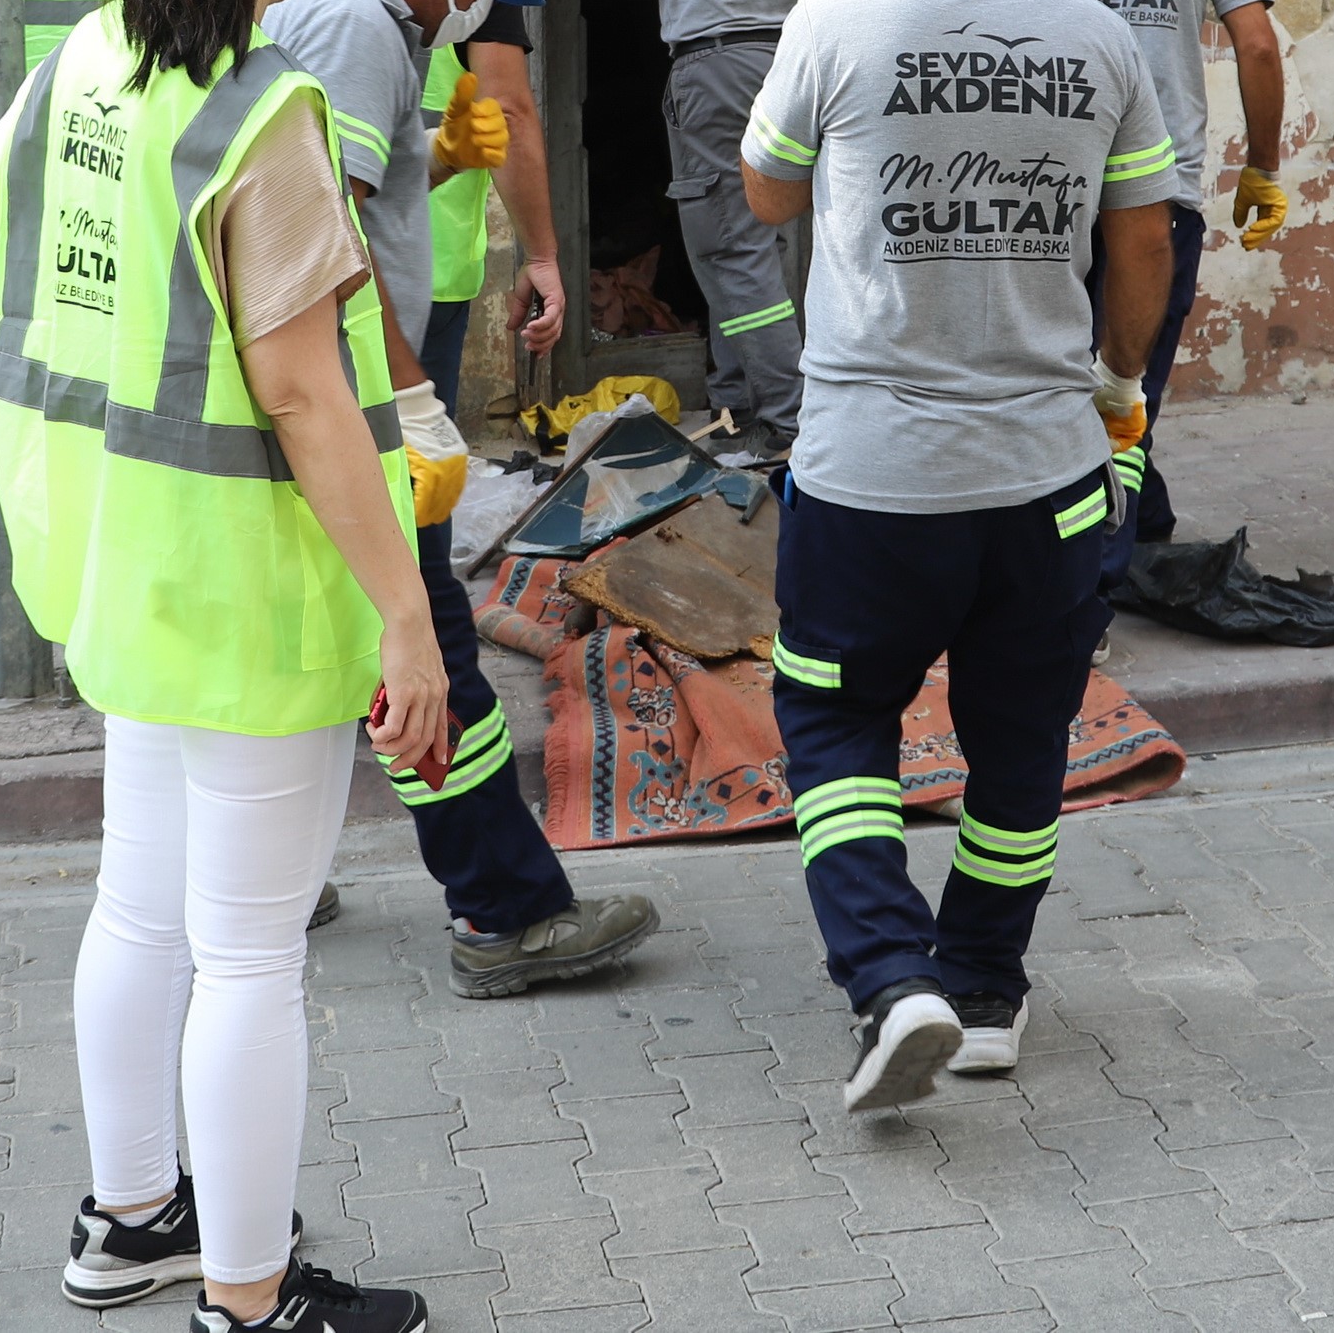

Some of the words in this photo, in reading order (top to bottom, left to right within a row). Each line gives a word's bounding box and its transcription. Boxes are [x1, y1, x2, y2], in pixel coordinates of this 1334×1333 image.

[895, 52, 1089, 85] SEVDAMIZ
[882, 78, 1097, 121] AKDENİZ
[60, 136, 124, 182] KDENİZ
[881, 199, 1084, 237] GÜLTAK
[883, 236, 950, 255] AKDENİZ
[954, 235, 1019, 254] BELEDİYE
